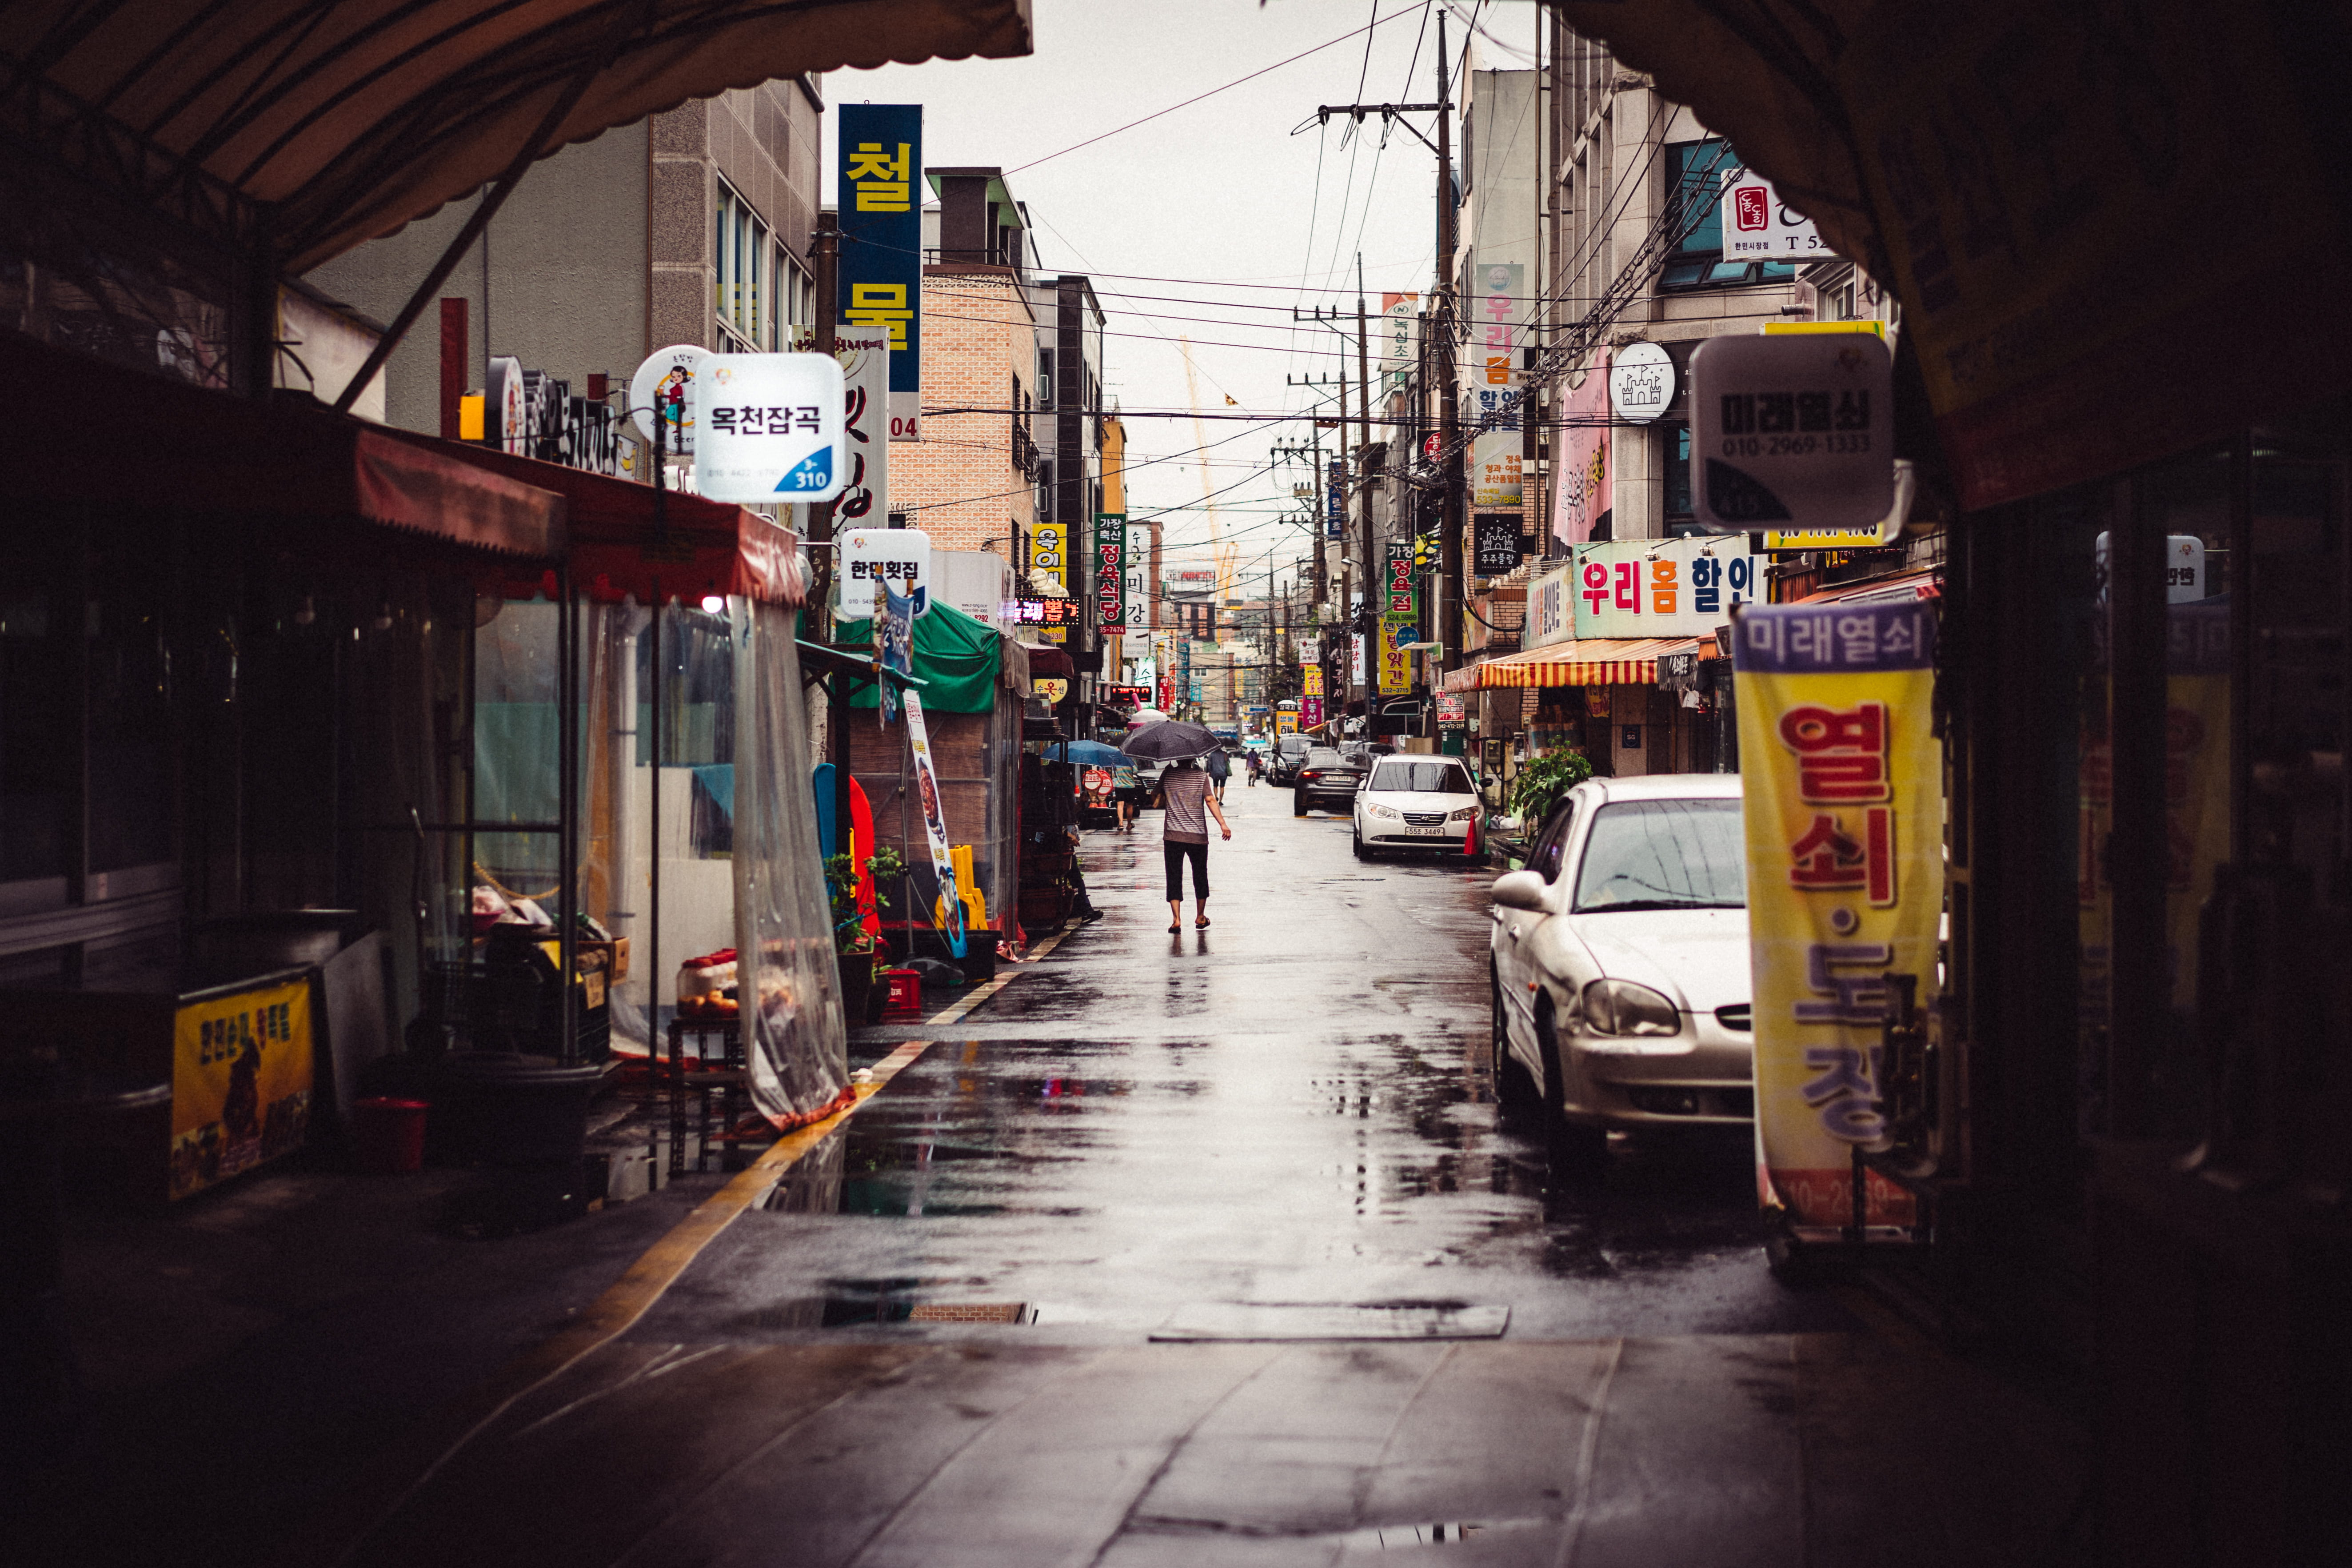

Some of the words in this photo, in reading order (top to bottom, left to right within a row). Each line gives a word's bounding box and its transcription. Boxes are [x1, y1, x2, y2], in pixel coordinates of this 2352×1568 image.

[846, 142, 913, 350] 철물
[1785, 236, 1799, 249] T
[1393, 319, 1409, 357] 녹십초
[1485, 294, 1513, 385] 우리홈
[711, 406, 821, 435] 옥천잡곡
[1505, 455, 1522, 464] 정육
[795, 471, 827, 488] 310
[1484, 475, 1522, 484] 공산품일절
[1476, 495, 1521, 504] 533-7890
[1100, 519, 1122, 530] 가장
[1099, 530, 1122, 541] 축산
[1388, 546, 1415, 559] 가장
[1481, 553, 1514, 564] 주주블랑
[1099, 544, 1122, 621] 정육식당
[1391, 560, 1412, 612] 정육점
[1746, 613, 1922, 663] 미래열쇠
[1306, 699, 1318, 724] 동산
